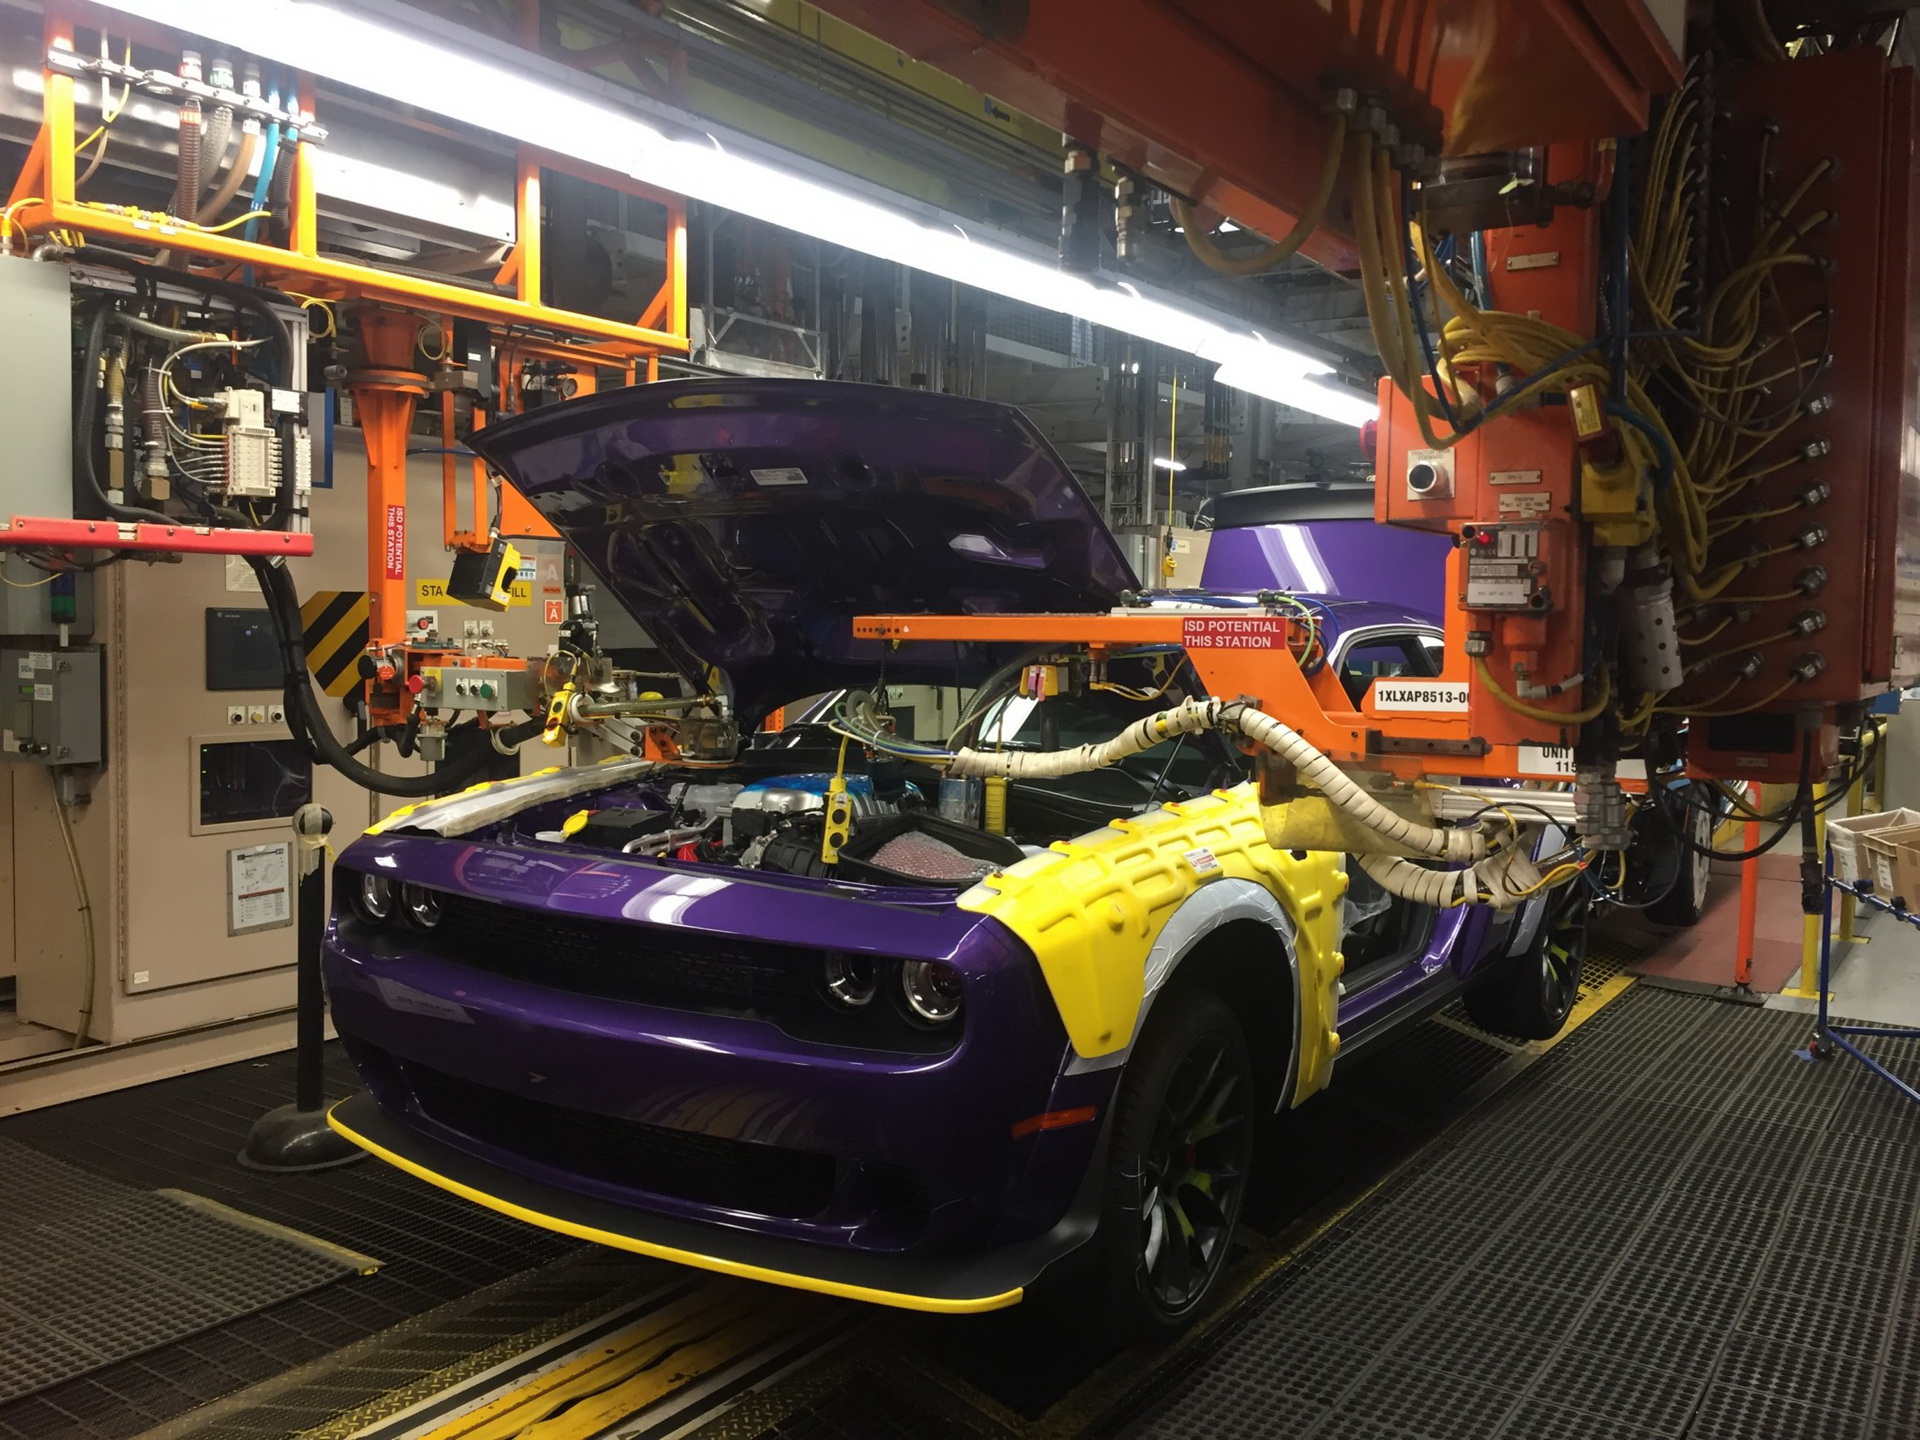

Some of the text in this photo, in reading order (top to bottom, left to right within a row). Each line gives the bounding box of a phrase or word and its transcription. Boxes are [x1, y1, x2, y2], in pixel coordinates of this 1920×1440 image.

[387, 507, 395, 569] THIS STATION
[395, 507, 404, 575] ISD POTENTIAL
[421, 585, 444, 597] STA
[549, 608, 559, 620] A
[1184, 620, 1280, 633] ISD POTENTIAL
[1184, 635, 1271, 648] THIS STATION
[1542, 746, 1570, 759] UNIT
[1556, 761, 1578, 773] 115
